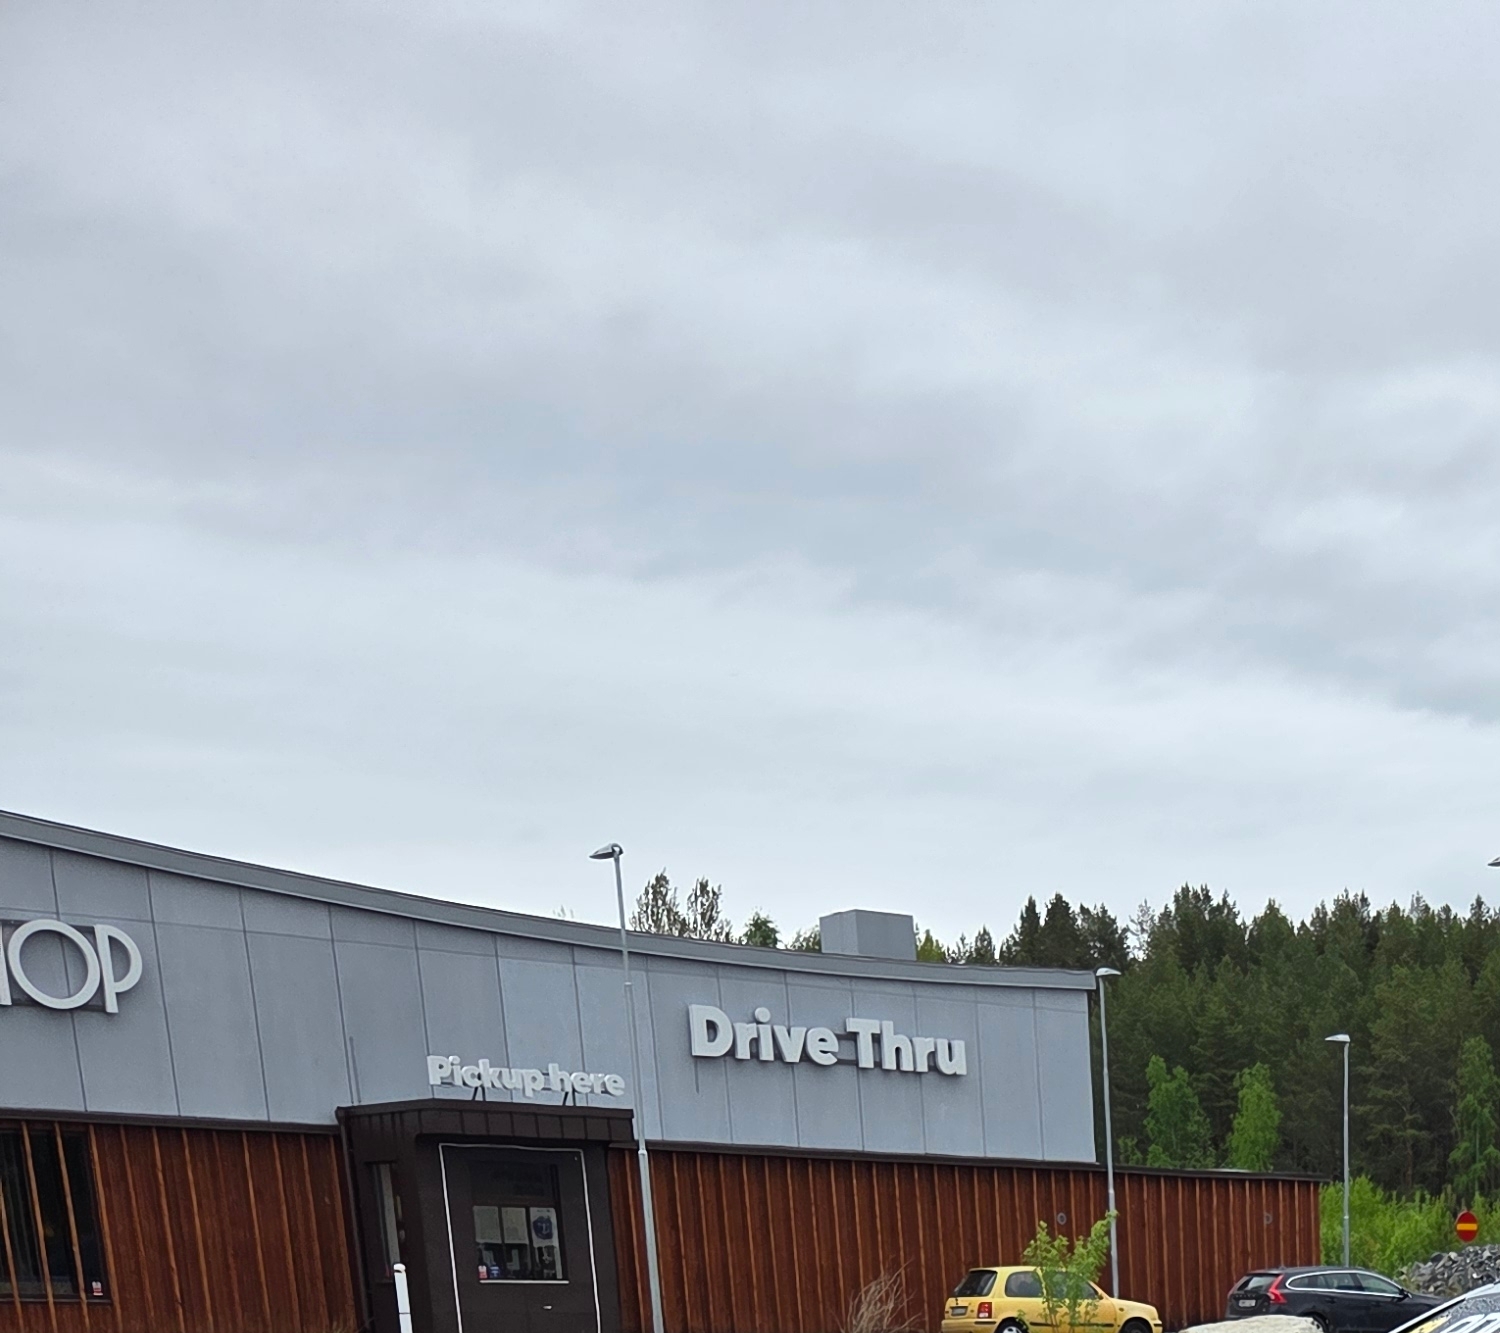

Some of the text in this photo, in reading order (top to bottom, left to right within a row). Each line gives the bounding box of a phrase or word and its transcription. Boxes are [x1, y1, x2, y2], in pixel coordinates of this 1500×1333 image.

[0, 919, 143, 1013] OP
[688, 1004, 968, 1076] Drive Thru
[548, 1063, 626, 1096] here
